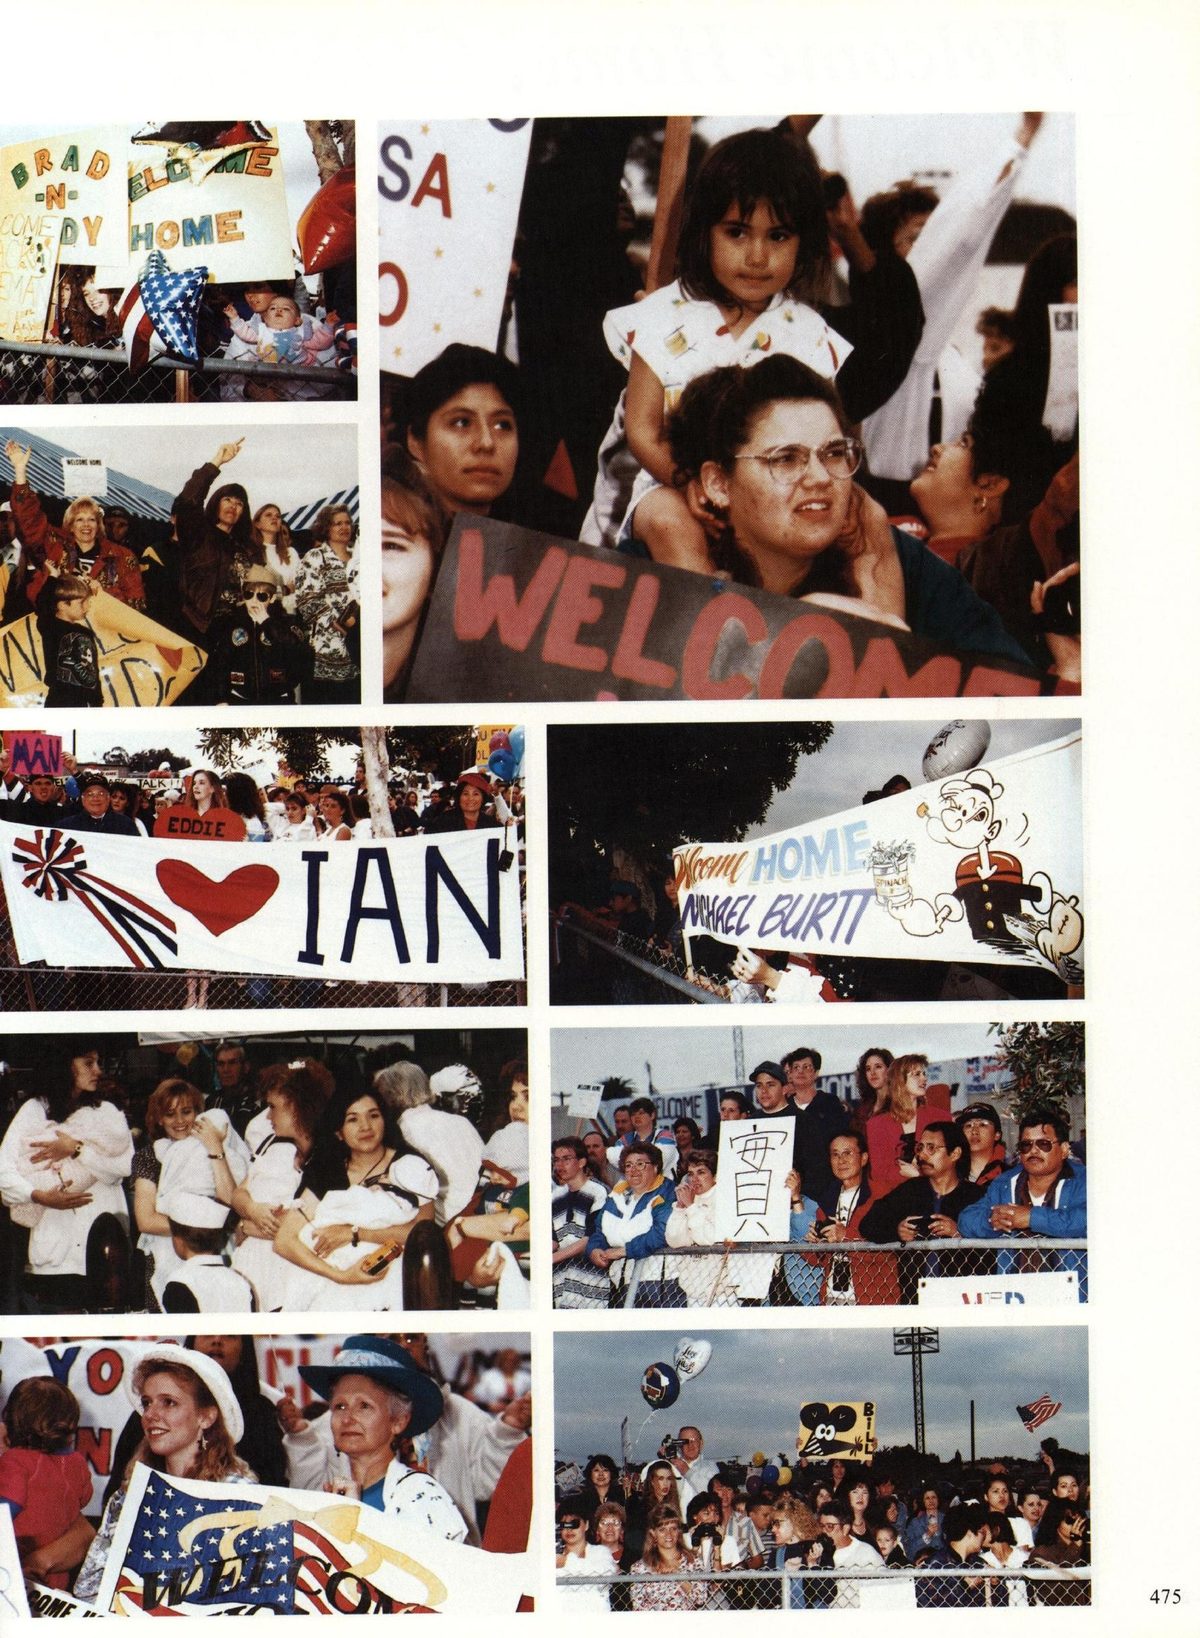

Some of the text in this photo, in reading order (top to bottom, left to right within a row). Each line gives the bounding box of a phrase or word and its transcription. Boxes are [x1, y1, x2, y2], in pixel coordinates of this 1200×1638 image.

[11, 145, 111, 190] BRAD
[130, 209, 245, 251] HOME
[452, 529, 1041, 700] WELCO
[11, 738, 62, 773] MAN
[137, 778, 166, 788] TALK
[168, 817, 226, 838] EDDIE
[751, 820, 872, 883] HOME
[297, 838, 501, 966] IAN
[757, 888, 877, 945] BURTT
[45, 1346, 124, 1396] YO
[1150, 1589, 1181, 1604] 475
